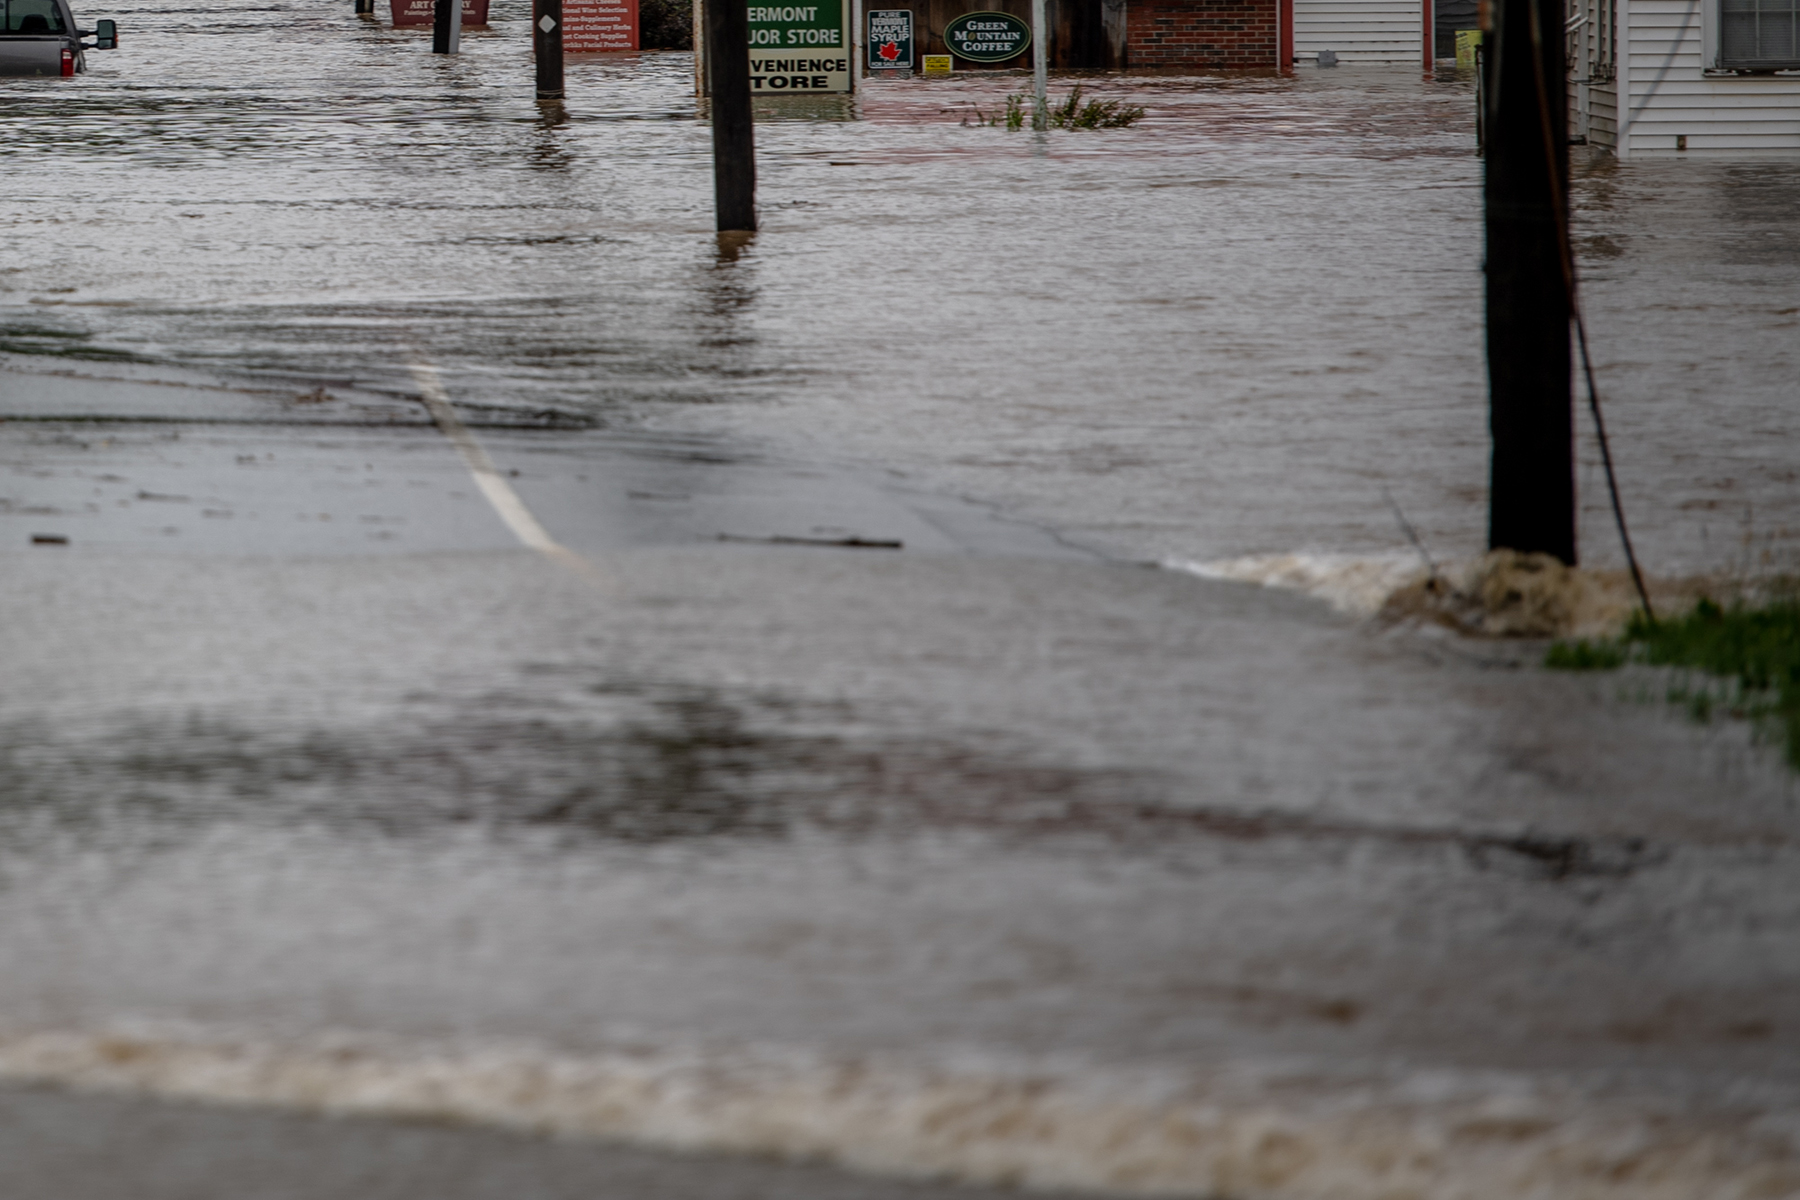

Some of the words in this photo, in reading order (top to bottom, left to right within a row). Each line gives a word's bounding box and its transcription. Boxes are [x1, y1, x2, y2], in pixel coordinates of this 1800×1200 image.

[409, 0, 430, 9] ART
[746, 7, 818, 22] ERMONT
[871, 17, 908, 26] VERMONT
[966, 20, 1009, 31] GREEN
[871, 25, 909, 33] MAPLE
[787, 29, 840, 44] STORE
[871, 33, 909, 42] SYRUP
[962, 42, 1014, 52] COFFEE
[750, 59, 847, 72] VENIENCE
[749, 76, 828, 88] TORE
